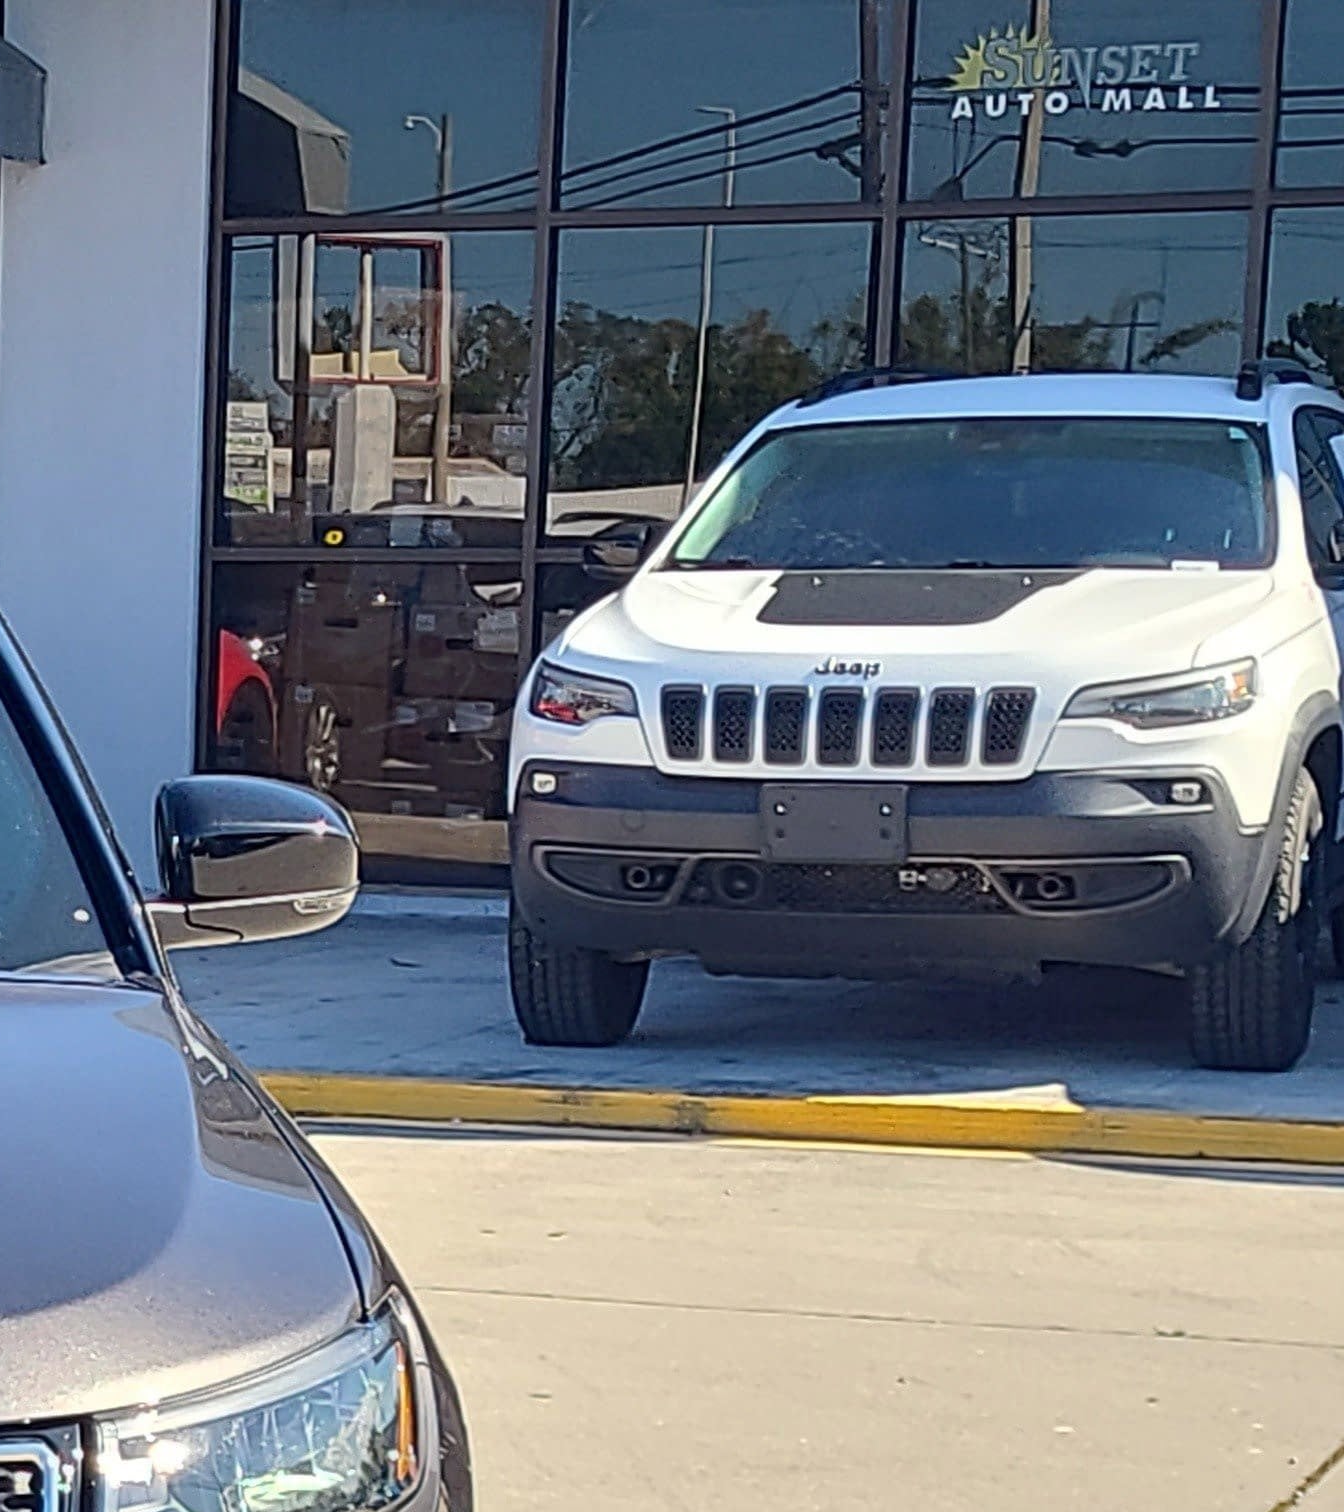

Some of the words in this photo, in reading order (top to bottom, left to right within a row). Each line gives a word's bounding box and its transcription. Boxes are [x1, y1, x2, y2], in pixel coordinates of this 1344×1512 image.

[979, 37, 1200, 110] SUNSET
[952, 92, 1070, 120] AUTO
[1102, 86, 1223, 113] MALL
[813, 655, 881, 680] Jeep
